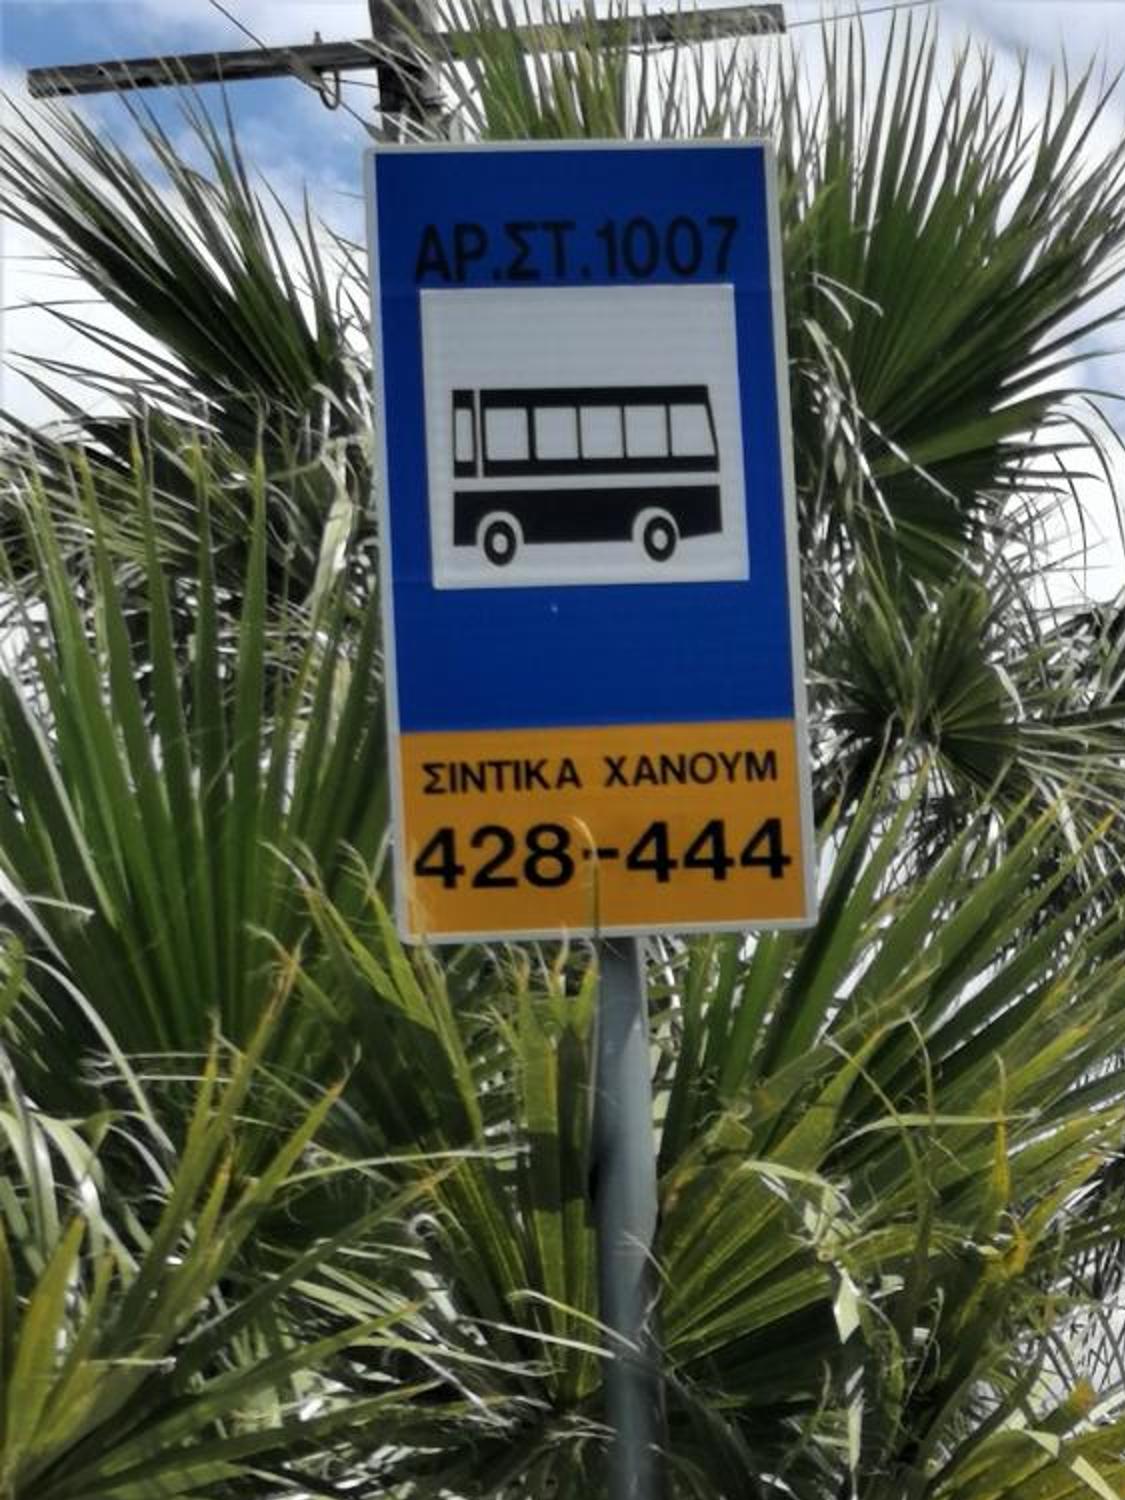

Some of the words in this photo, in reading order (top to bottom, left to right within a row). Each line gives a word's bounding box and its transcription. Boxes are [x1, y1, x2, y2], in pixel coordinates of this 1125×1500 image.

[421, 757, 583, 795] ΣΙΝΤΙΚΑ
[603, 749, 778, 789] ΧΑΝΟΥΜ
[413, 817, 792, 890] 428-444
